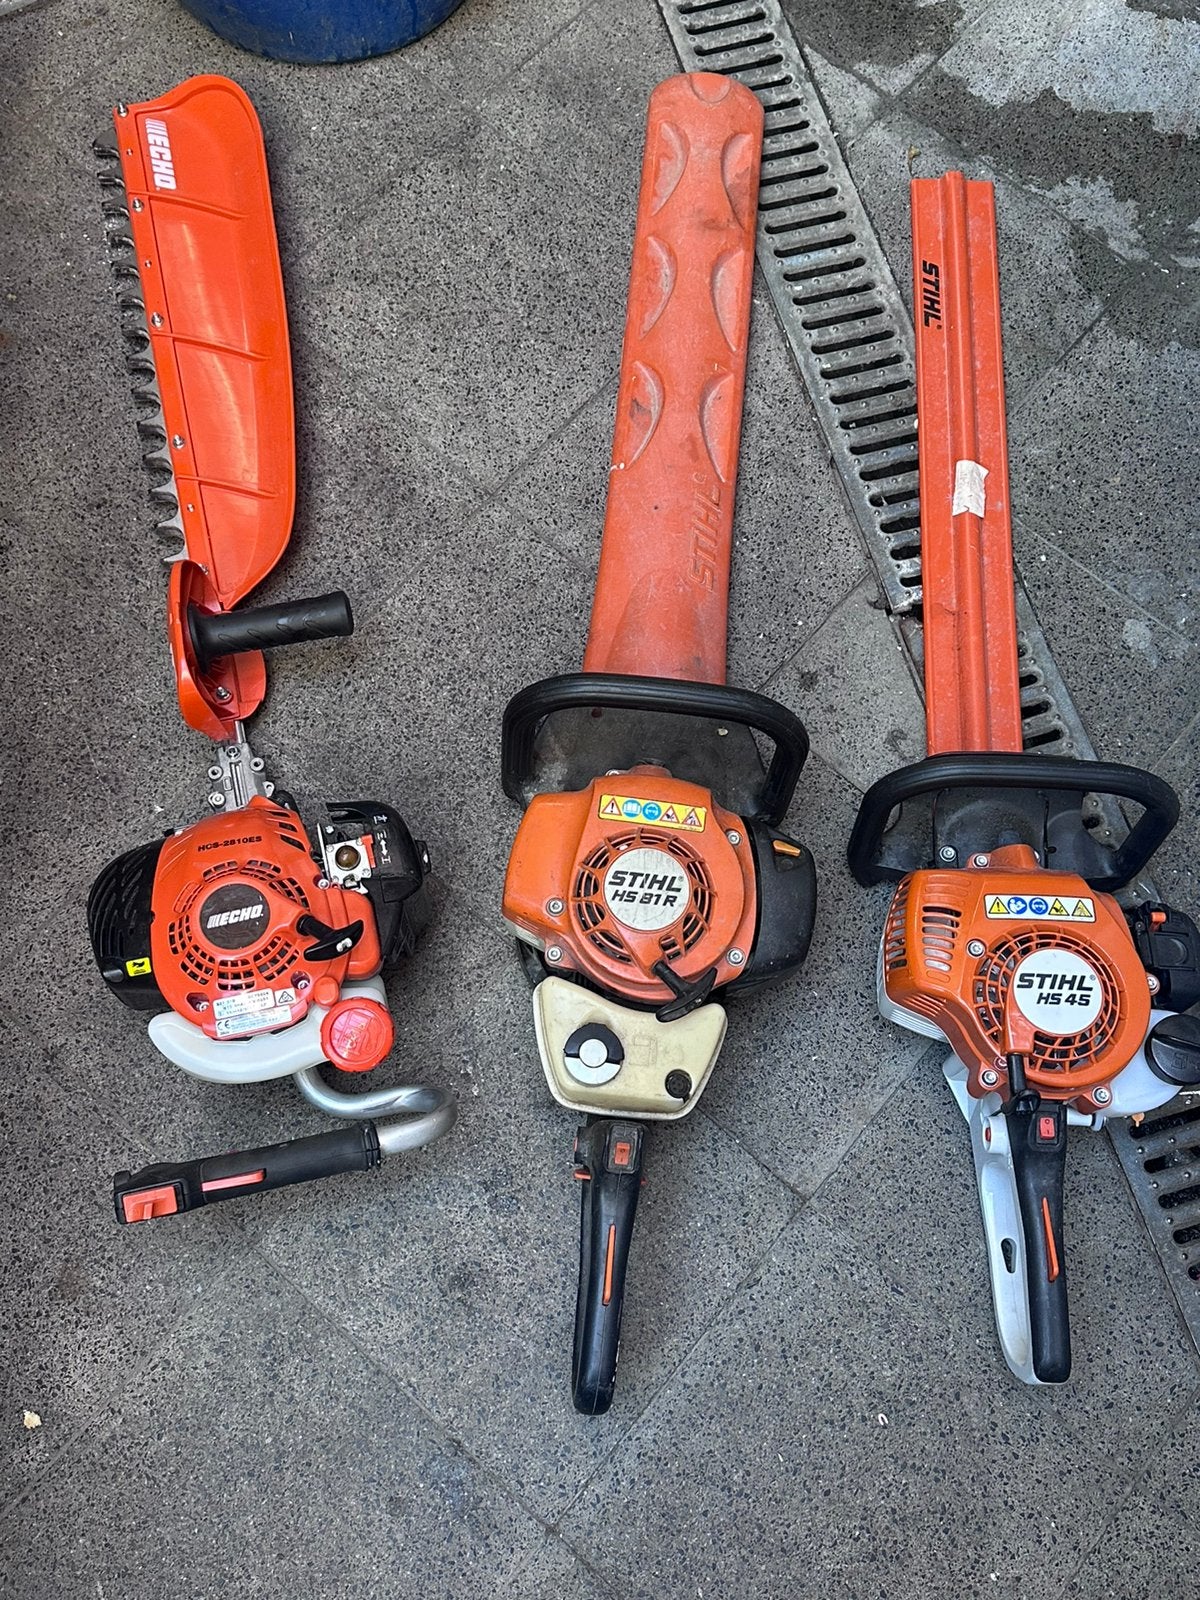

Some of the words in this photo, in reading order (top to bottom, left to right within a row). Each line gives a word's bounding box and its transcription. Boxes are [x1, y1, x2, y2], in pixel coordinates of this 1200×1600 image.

[922, 259, 941, 327] STIHL
[688, 484, 722, 592] STIHL
[197, 836, 262, 852] HCS-2810ES
[608, 870, 682, 893] STIHL
[611, 890, 639, 903] HS
[639, 893, 662, 906] 81
[662, 896, 677, 907] R
[1016, 972, 1094, 992] STIHL
[1036, 992, 1063, 1006] HS
[1065, 993, 1091, 1006] 45
